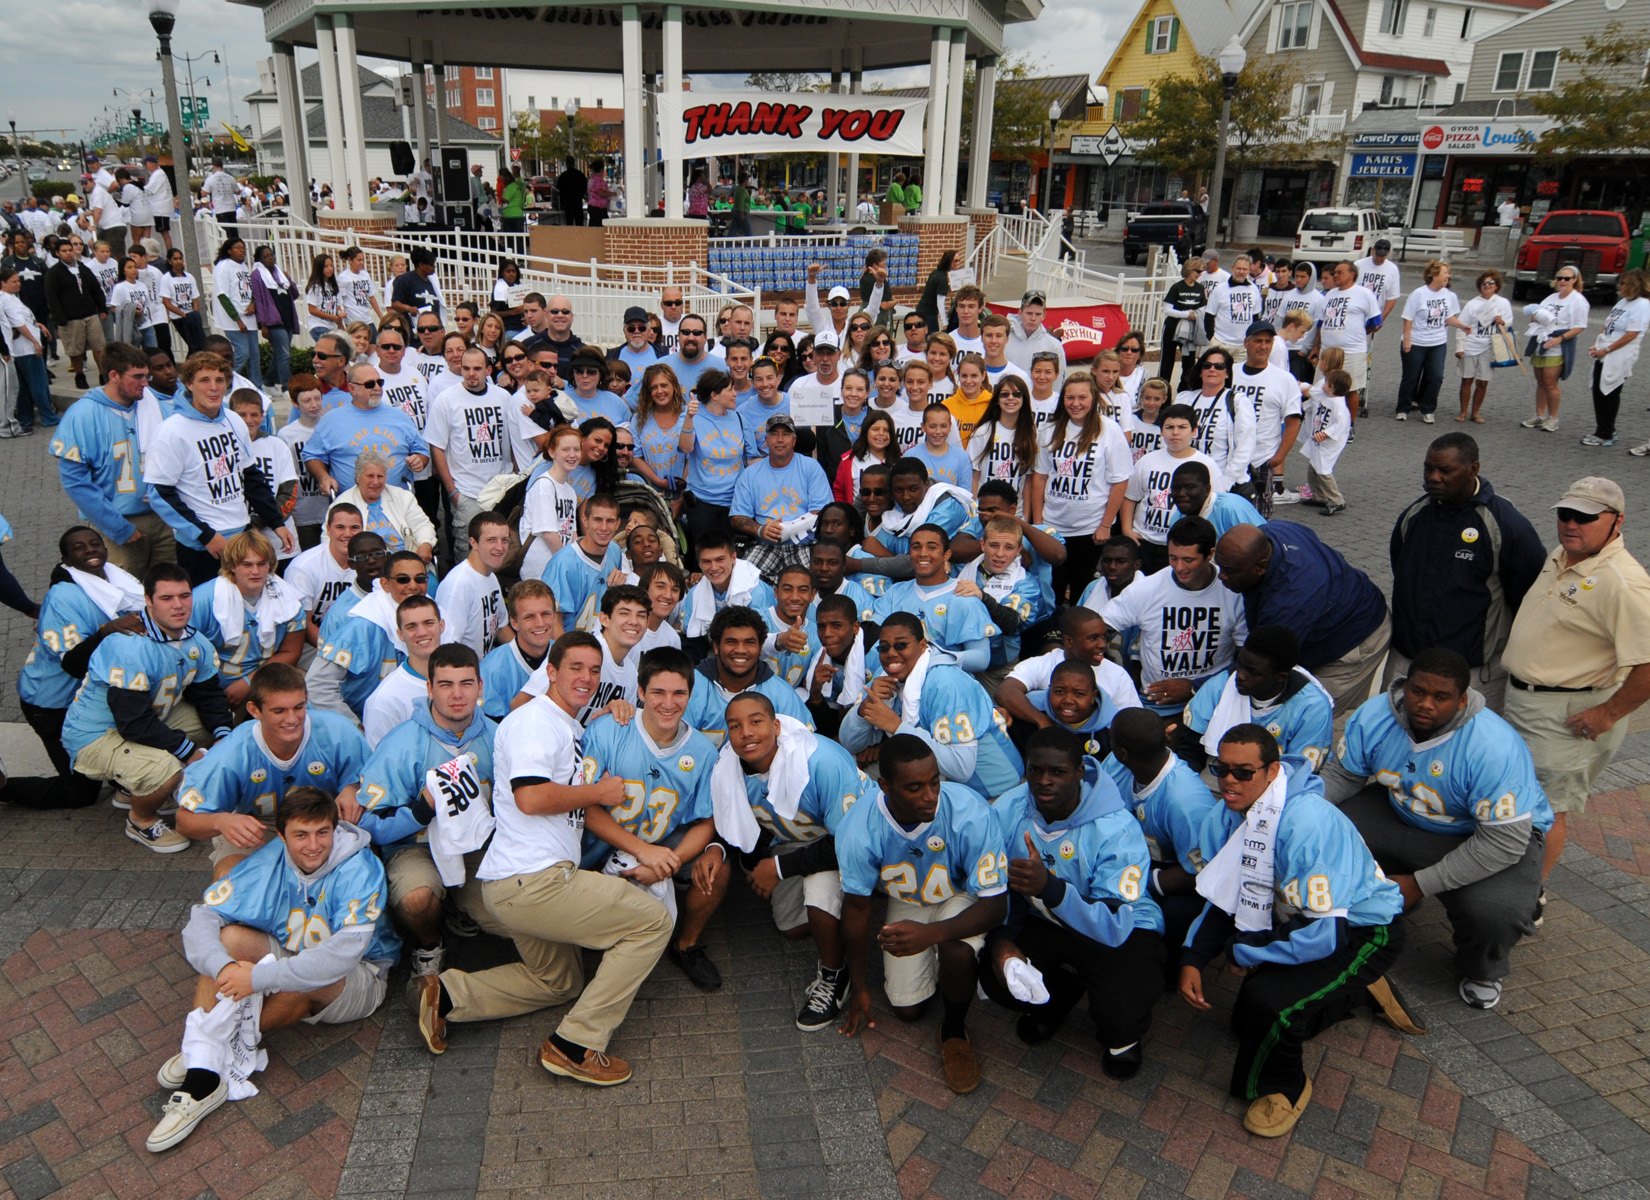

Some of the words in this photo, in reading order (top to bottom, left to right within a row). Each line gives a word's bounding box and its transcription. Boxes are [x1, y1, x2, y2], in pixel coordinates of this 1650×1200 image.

[683, 101, 813, 143] THANK
[817, 107, 905, 141] YOU
[1355, 133, 1399, 145] Jewelry
[1445, 134, 1480, 142] PIZZA
[1356, 165, 1408, 175] JEWELRY
[1363, 272, 1386, 284] HOPE
[1229, 293, 1252, 303] HOPE
[1326, 297, 1350, 308] HOPE
[1426, 298, 1448, 309] HOPE
[1426, 317, 1446, 328] WAL
[1079, 328, 1099, 341] HILL
[386, 384, 422, 405] HOPE
[464, 406, 503, 425] HOPE
[350, 427, 370, 447] THE
[700, 429, 719, 447] THE
[896, 427, 924, 445] HOP
[1131, 432, 1161, 450] HOPE
[52, 439, 81, 463] 74
[197, 431, 240, 462] HOPE
[650, 442, 673, 454] ALS
[710, 447, 739, 459] ALS
[113, 439, 144, 493] 7
[701, 458, 742, 477] KICKERS
[1052, 477, 1091, 495] WALK
[761, 489, 779, 511] THE
[770, 504, 798, 520] ALS
[1145, 508, 1171, 529] WAL
[1162, 607, 1221, 630] HOPE
[43, 624, 82, 653] 35
[1161, 650, 1217, 672] WALK
[108, 667, 149, 692] 54
[933, 712, 975, 745] 63
[611, 779, 679, 844] 23
[977, 851, 1008, 887] 24
[880, 861, 956, 907] 24
[1118, 864, 1142, 901] 6
[1283, 874, 1333, 913] 88
